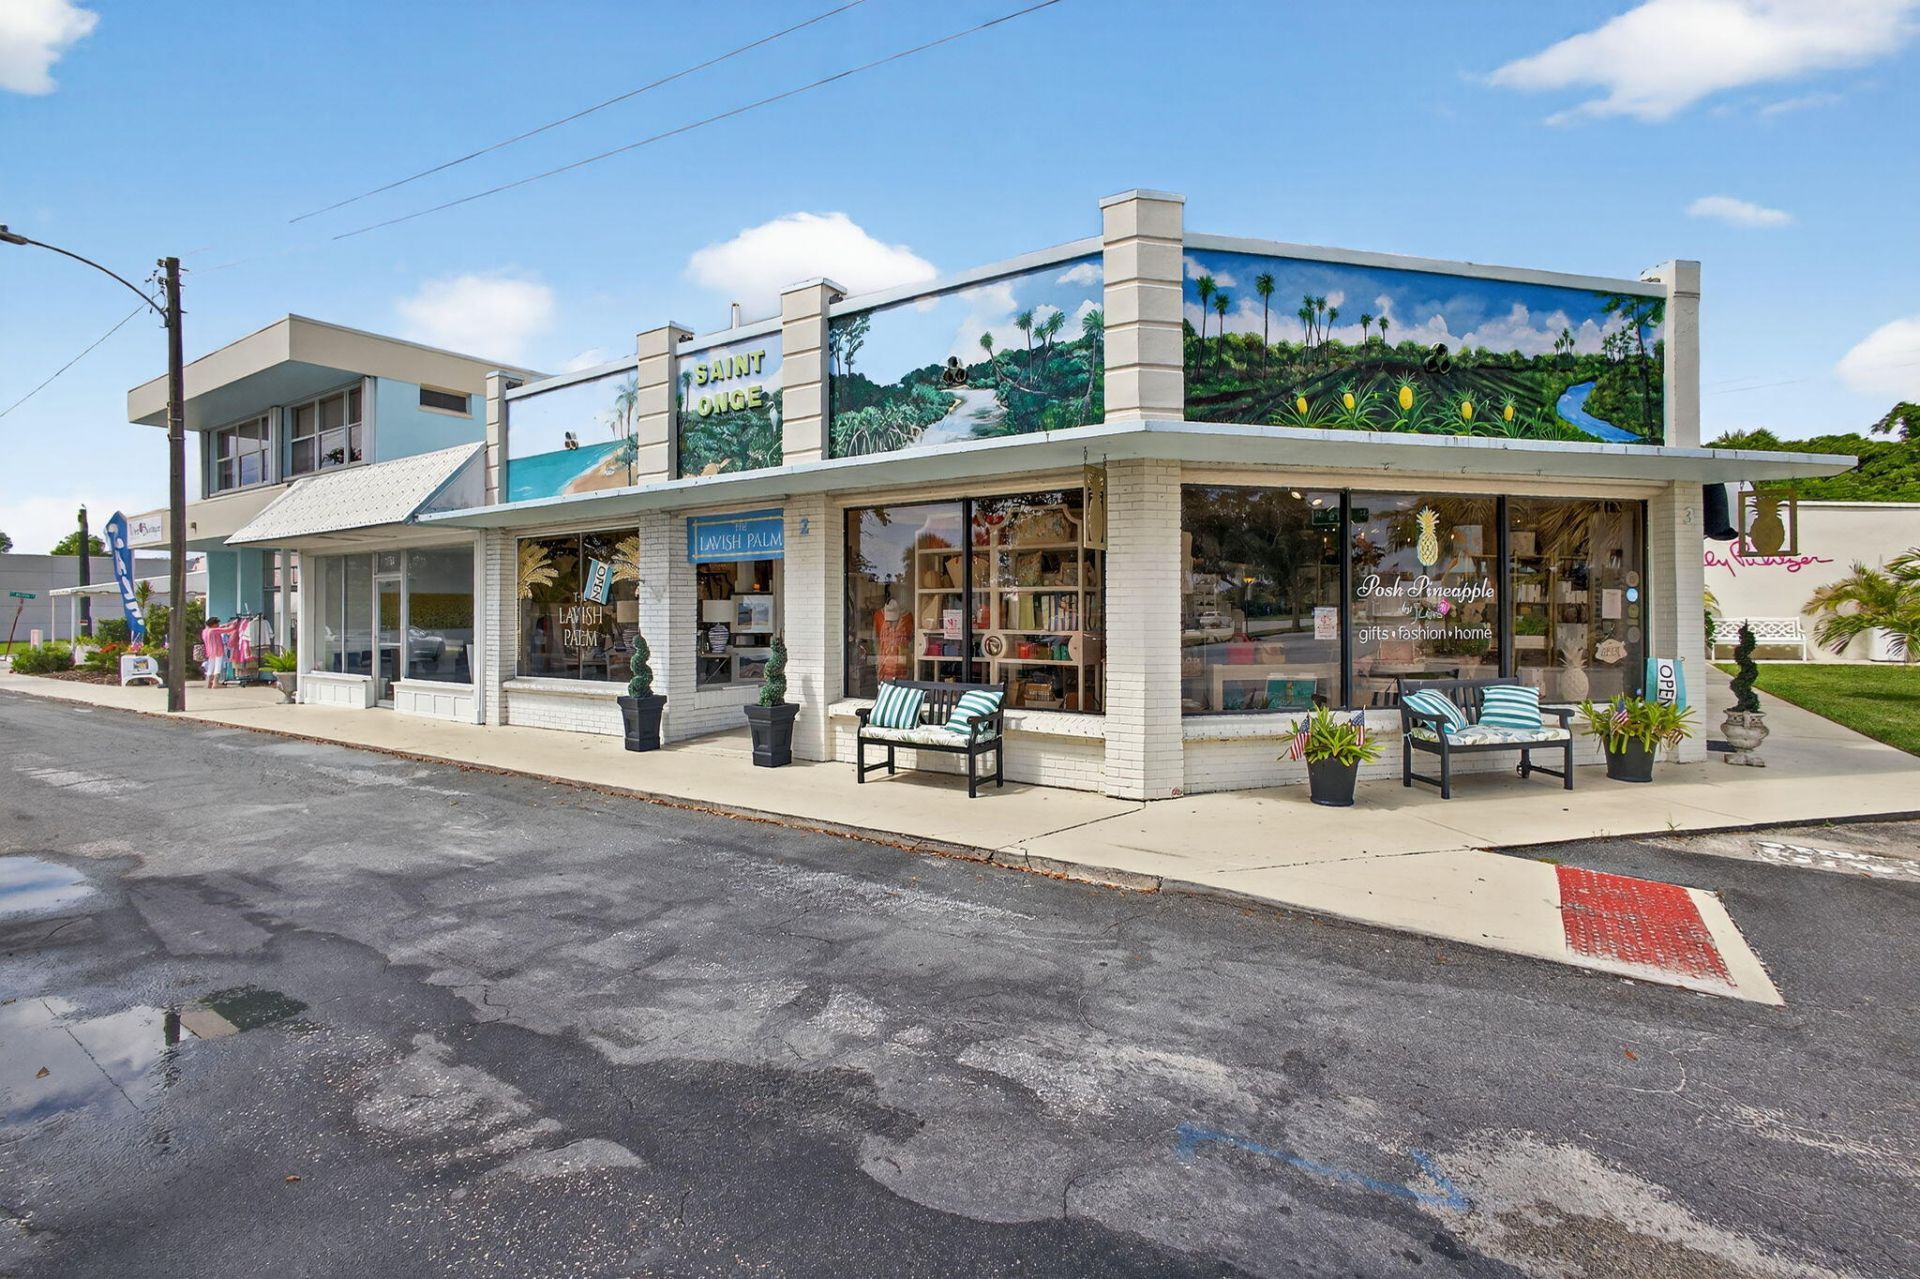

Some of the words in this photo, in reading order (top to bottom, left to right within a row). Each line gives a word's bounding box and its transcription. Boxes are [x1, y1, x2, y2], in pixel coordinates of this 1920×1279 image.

[694, 350, 765, 386] SAINT
[698, 385, 763, 417] ONGE
[1683, 506, 1696, 526] 3
[700, 533, 741, 552] LAVISH
[747, 530, 784, 549] PALM
[590, 565, 607, 601] OPEN
[1356, 574, 1405, 598] Posh
[1407, 574, 1495, 604] Pineapple
[559, 605, 603, 626] LAVISH
[563, 628, 598, 647] PALM
[1359, 626, 1389, 644] gifts
[1398, 625, 1447, 641] fashion
[1454, 625, 1493, 641] home
[1658, 664, 1676, 707] OPEN
